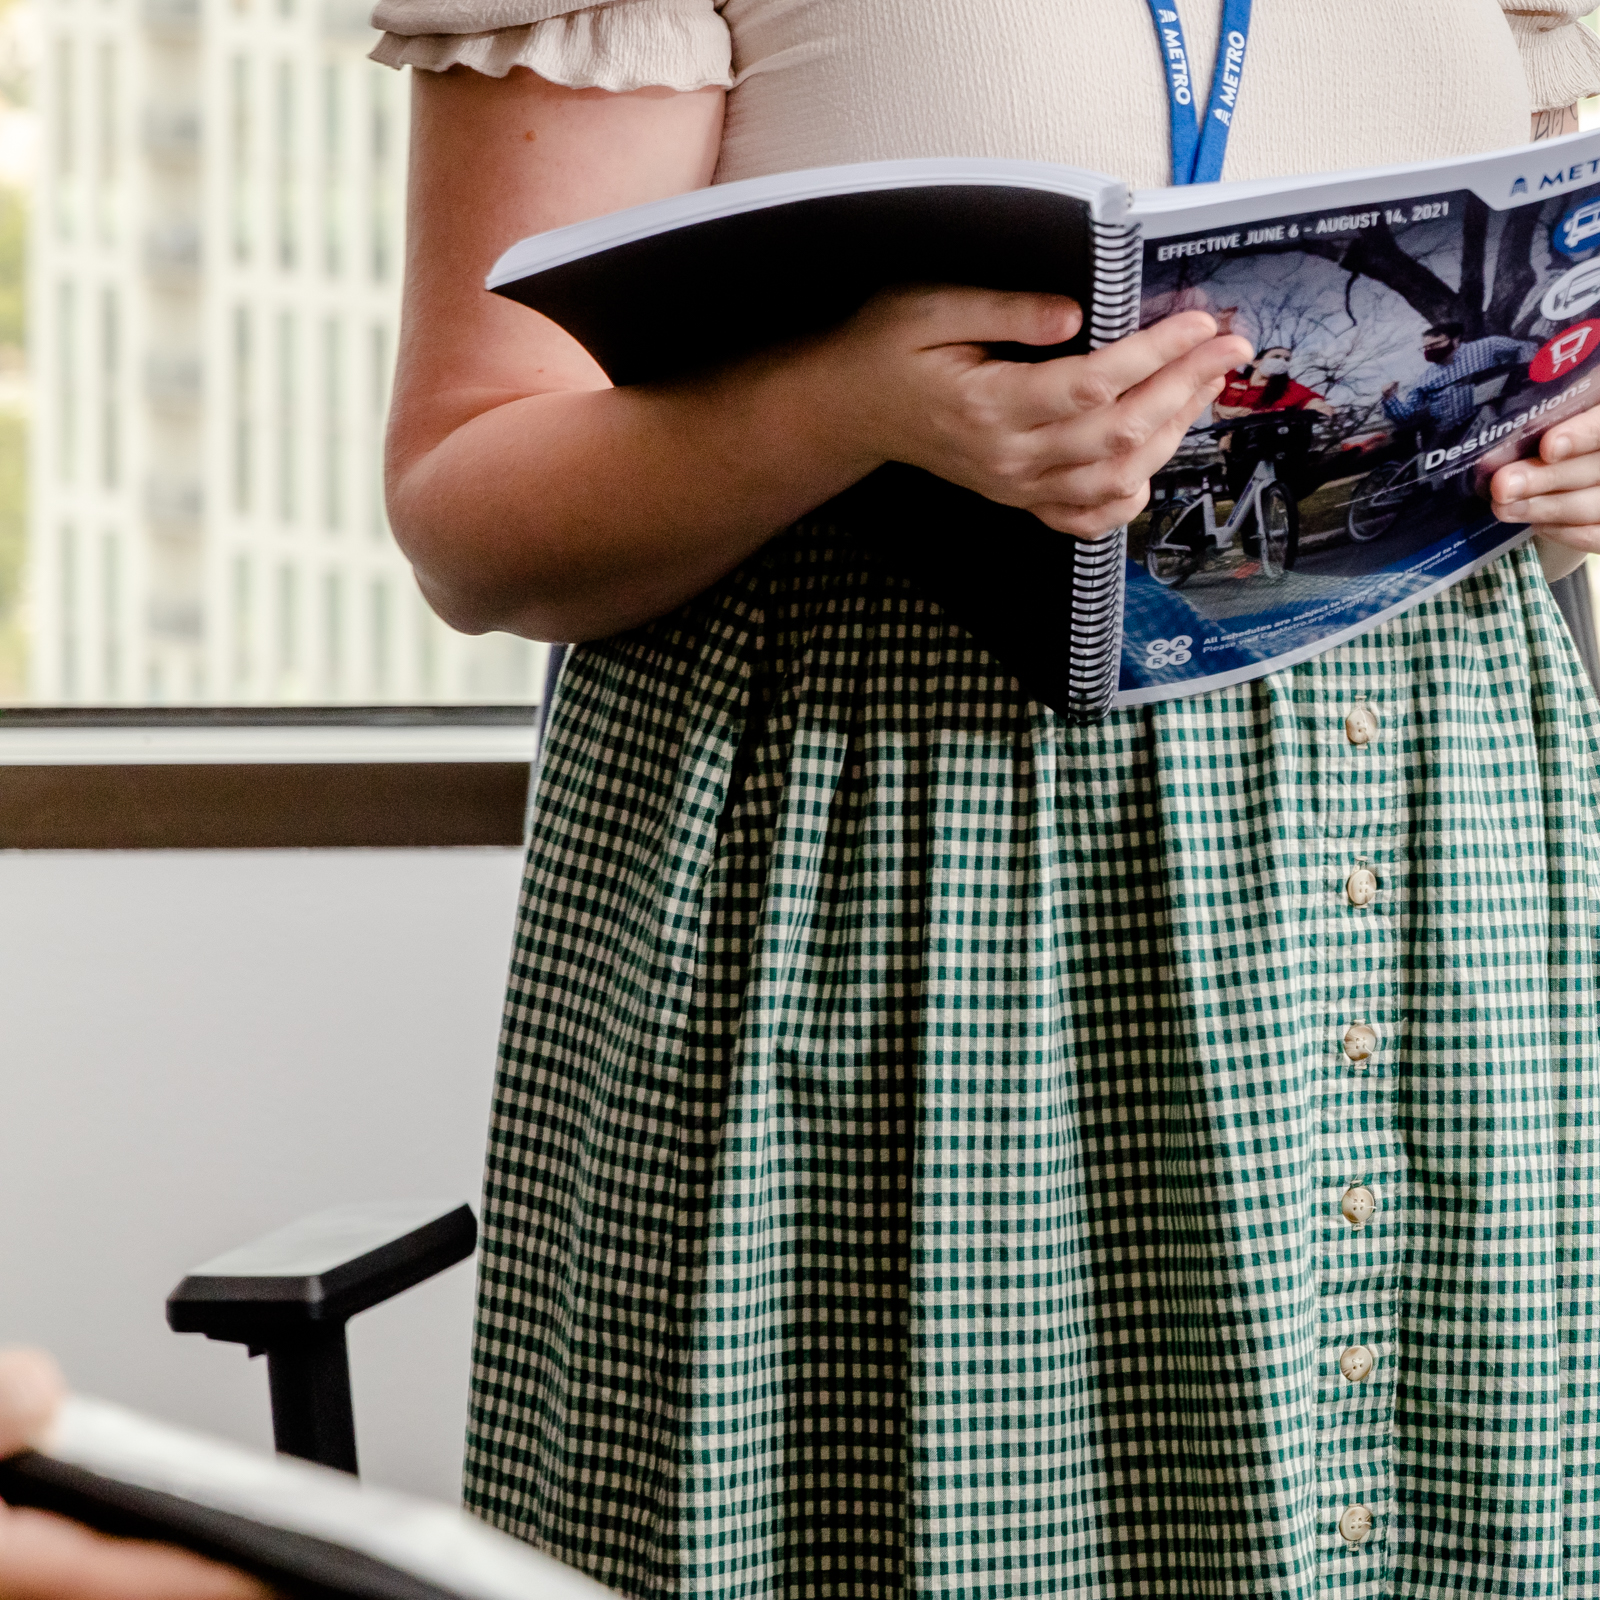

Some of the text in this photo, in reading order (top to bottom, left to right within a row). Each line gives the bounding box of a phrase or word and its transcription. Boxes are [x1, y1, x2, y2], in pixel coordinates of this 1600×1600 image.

[1162, 26, 1192, 106] METRO
[1219, 30, 1246, 109] METRO
[1156, 232, 1241, 262] EFFECTIVE
[1244, 225, 1286, 246] JUNE
[1288, 223, 1299, 239] 6
[1315, 211, 1381, 234] AUGUST
[1384, 208, 1408, 225] 14,
[1411, 201, 1450, 221] 2021
[1424, 377, 1593, 471] Destinations
[1442, 546, 1452, 555] to
[1453, 538, 1467, 549] the
[1203, 635, 1218, 645] All
[1220, 623, 1273, 642] schedules
[1273, 618, 1292, 628] are
[1292, 604, 1329, 622] subject
[1330, 600, 1341, 608] to
[1203, 641, 1237, 653] Please
